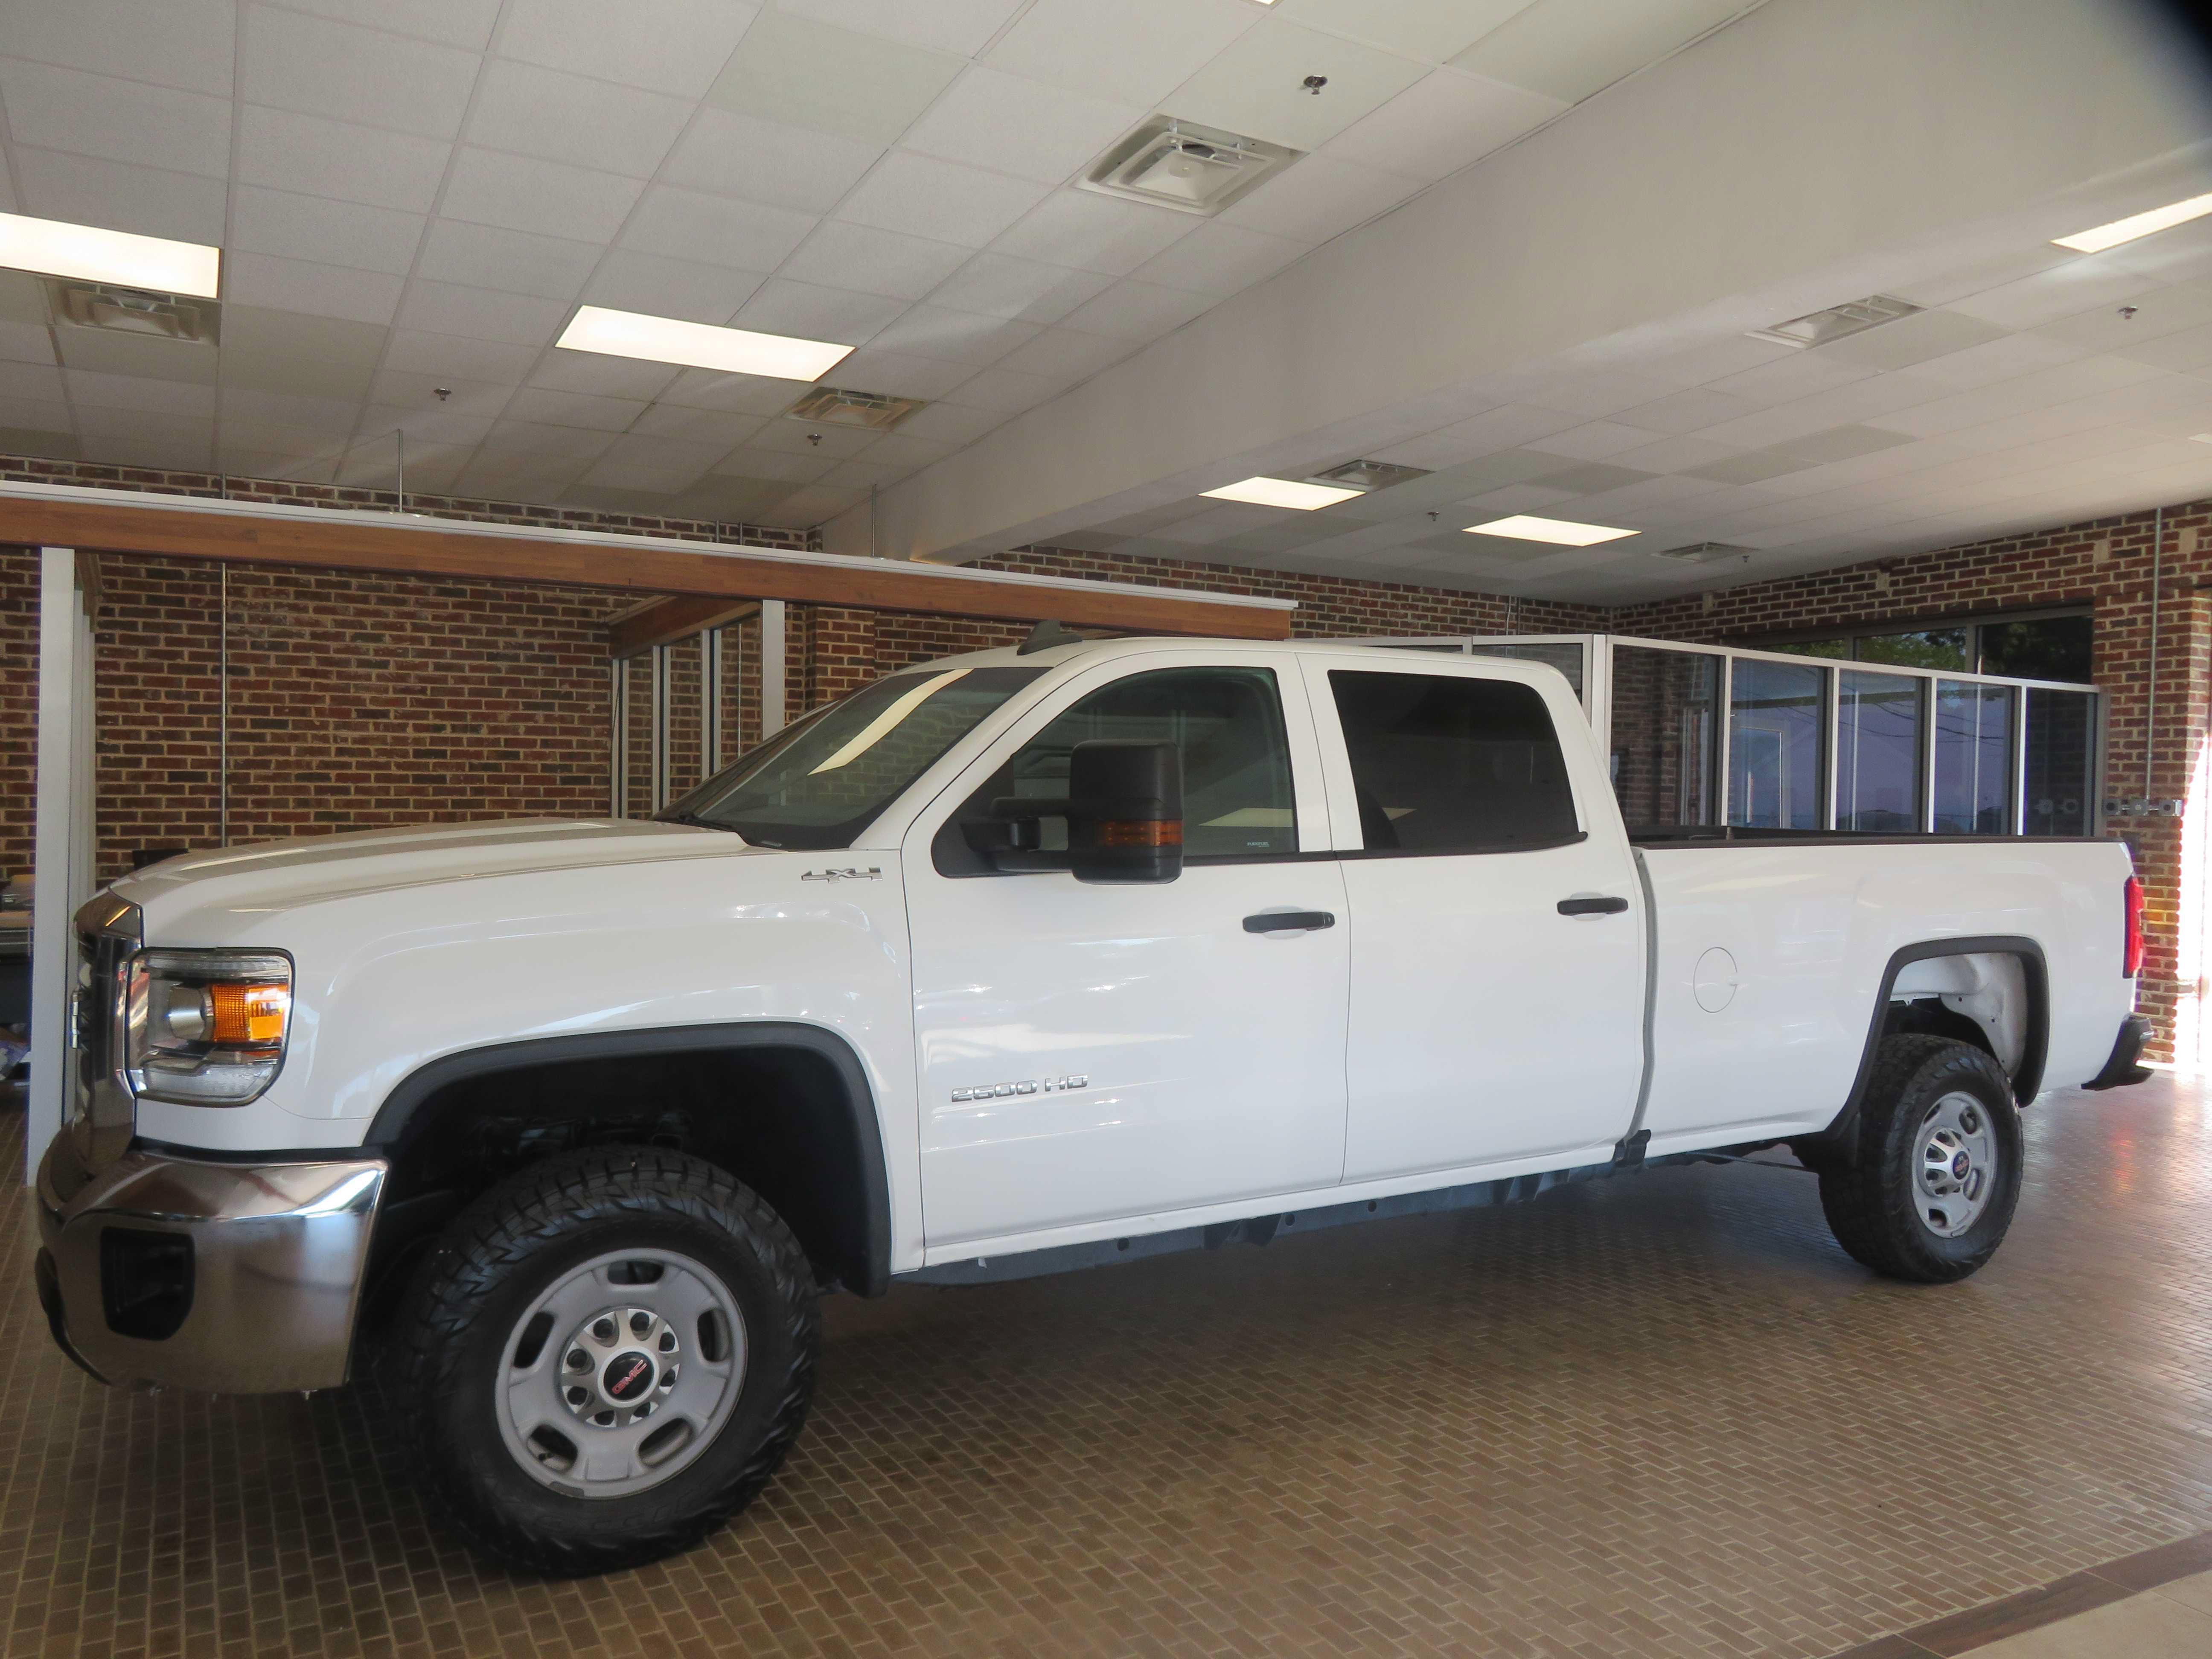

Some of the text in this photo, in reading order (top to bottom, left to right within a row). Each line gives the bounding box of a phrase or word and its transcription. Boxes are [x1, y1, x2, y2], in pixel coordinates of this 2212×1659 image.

[951, 1074, 1089, 1103] 2500 HD
[611, 1359, 648, 1395] GMC
